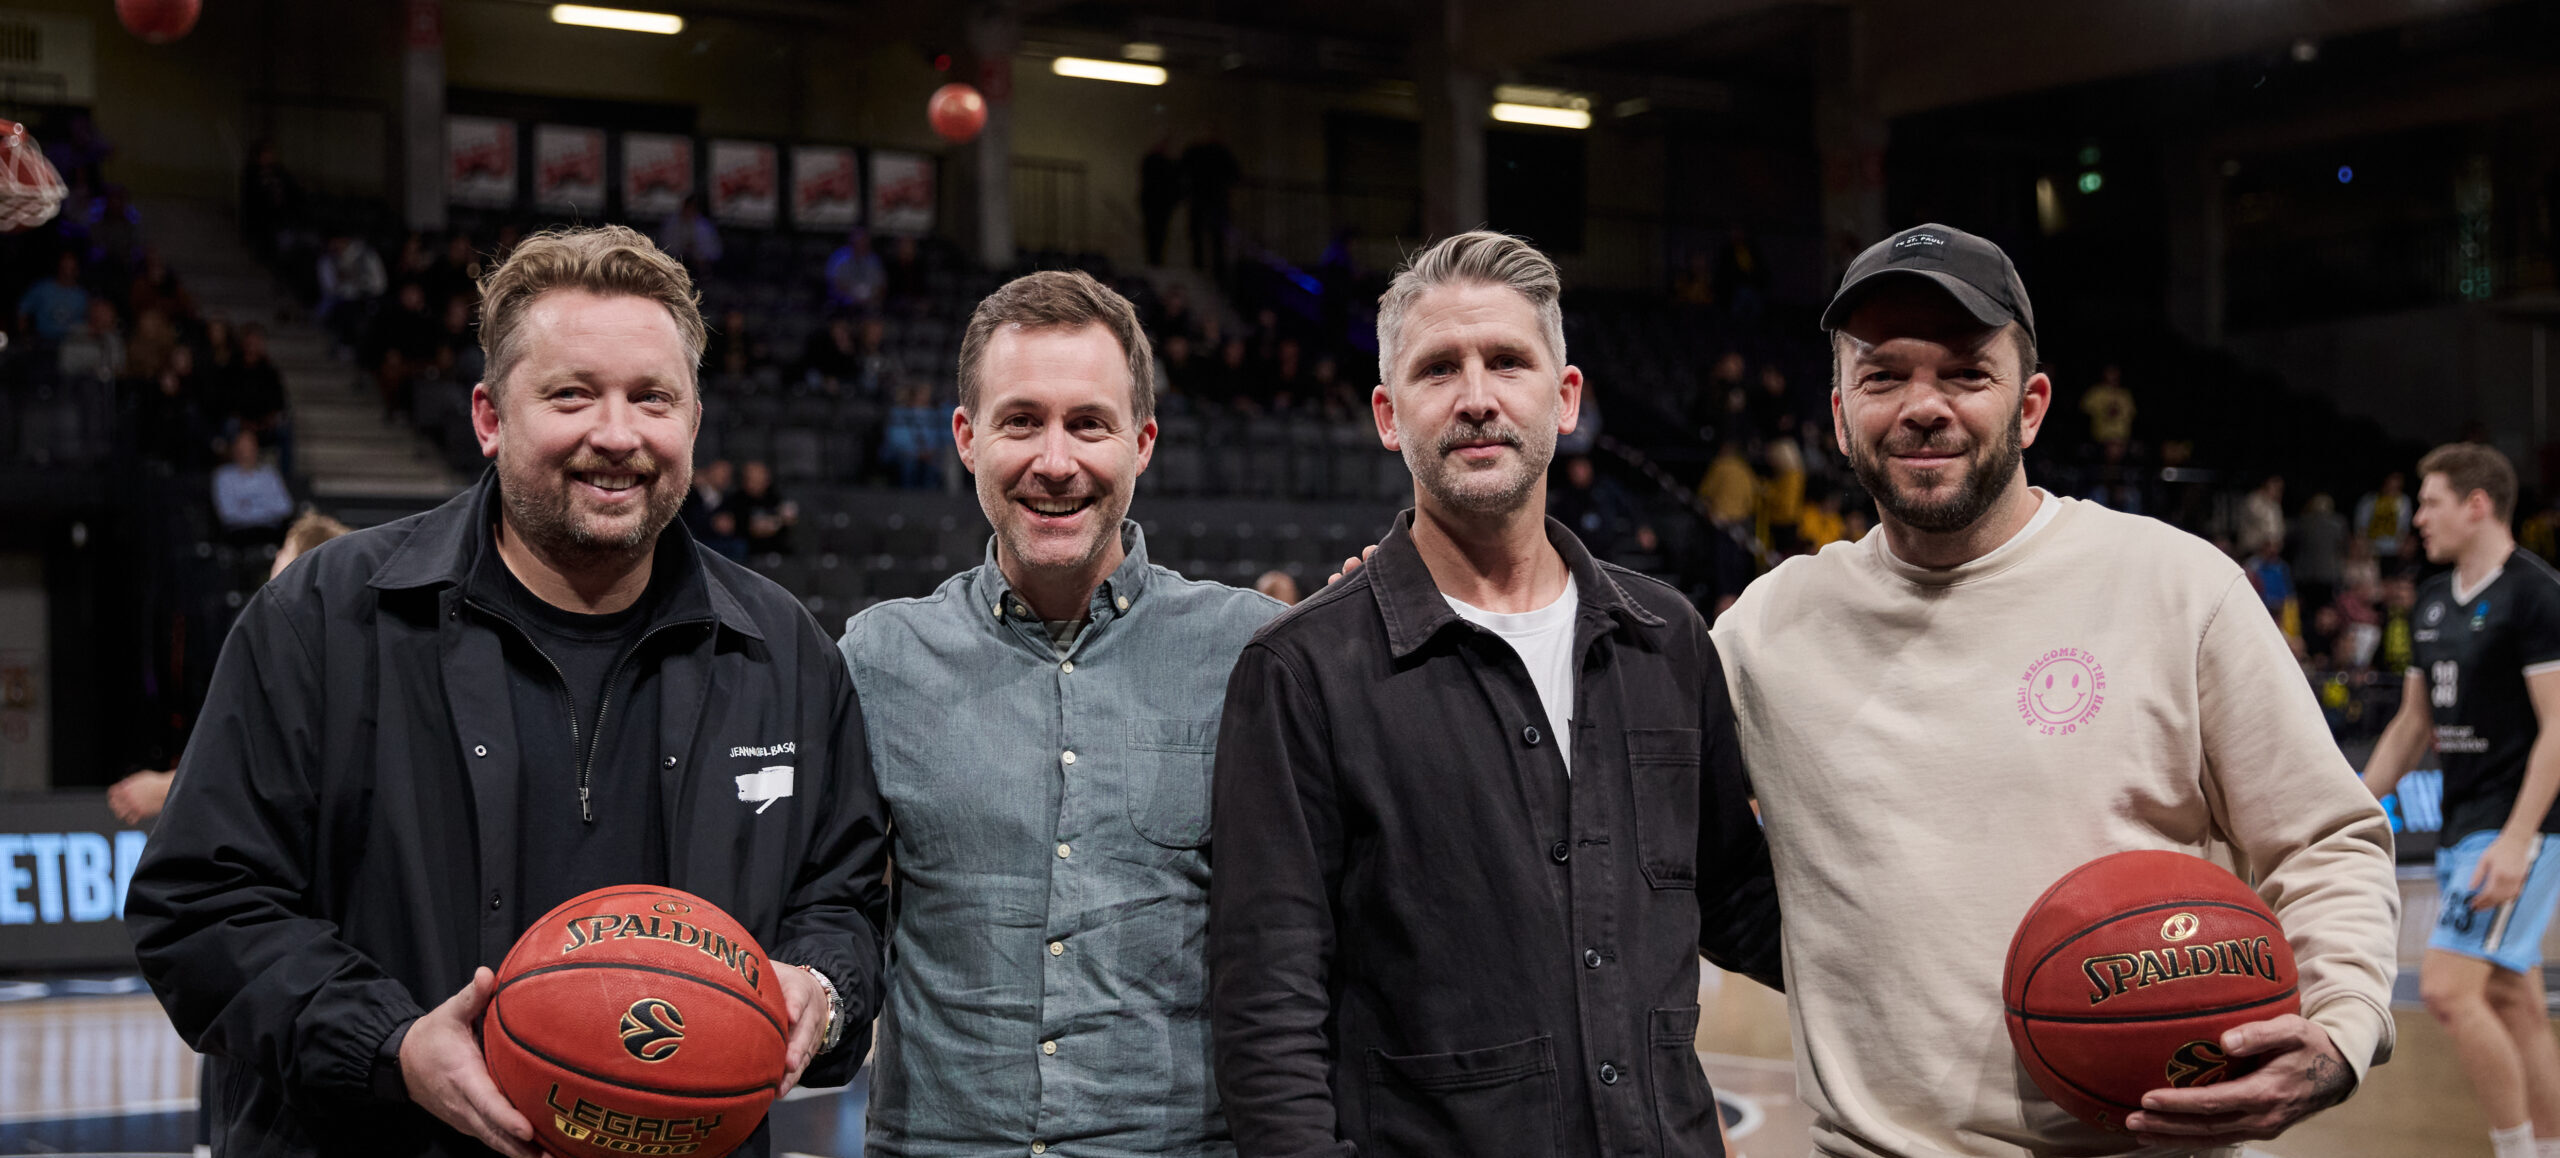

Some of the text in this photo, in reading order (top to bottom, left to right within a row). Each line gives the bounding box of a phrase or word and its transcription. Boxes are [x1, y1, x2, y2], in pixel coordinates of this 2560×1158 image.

[2022, 647, 2078, 681] WELCOME
[2081, 651, 2095, 663] TO
[2092, 663, 2106, 690] THE
[2016, 687, 2037, 727] PAULI!
[2079, 694, 2105, 725] HELL
[2060, 723, 2077, 736] OF
[562, 913, 760, 991] SPALDING
[2082, 936, 2276, 1008] SPALDING
[546, 1081, 722, 1142] LEGACY
[591, 1133, 702, 1156] 1000
